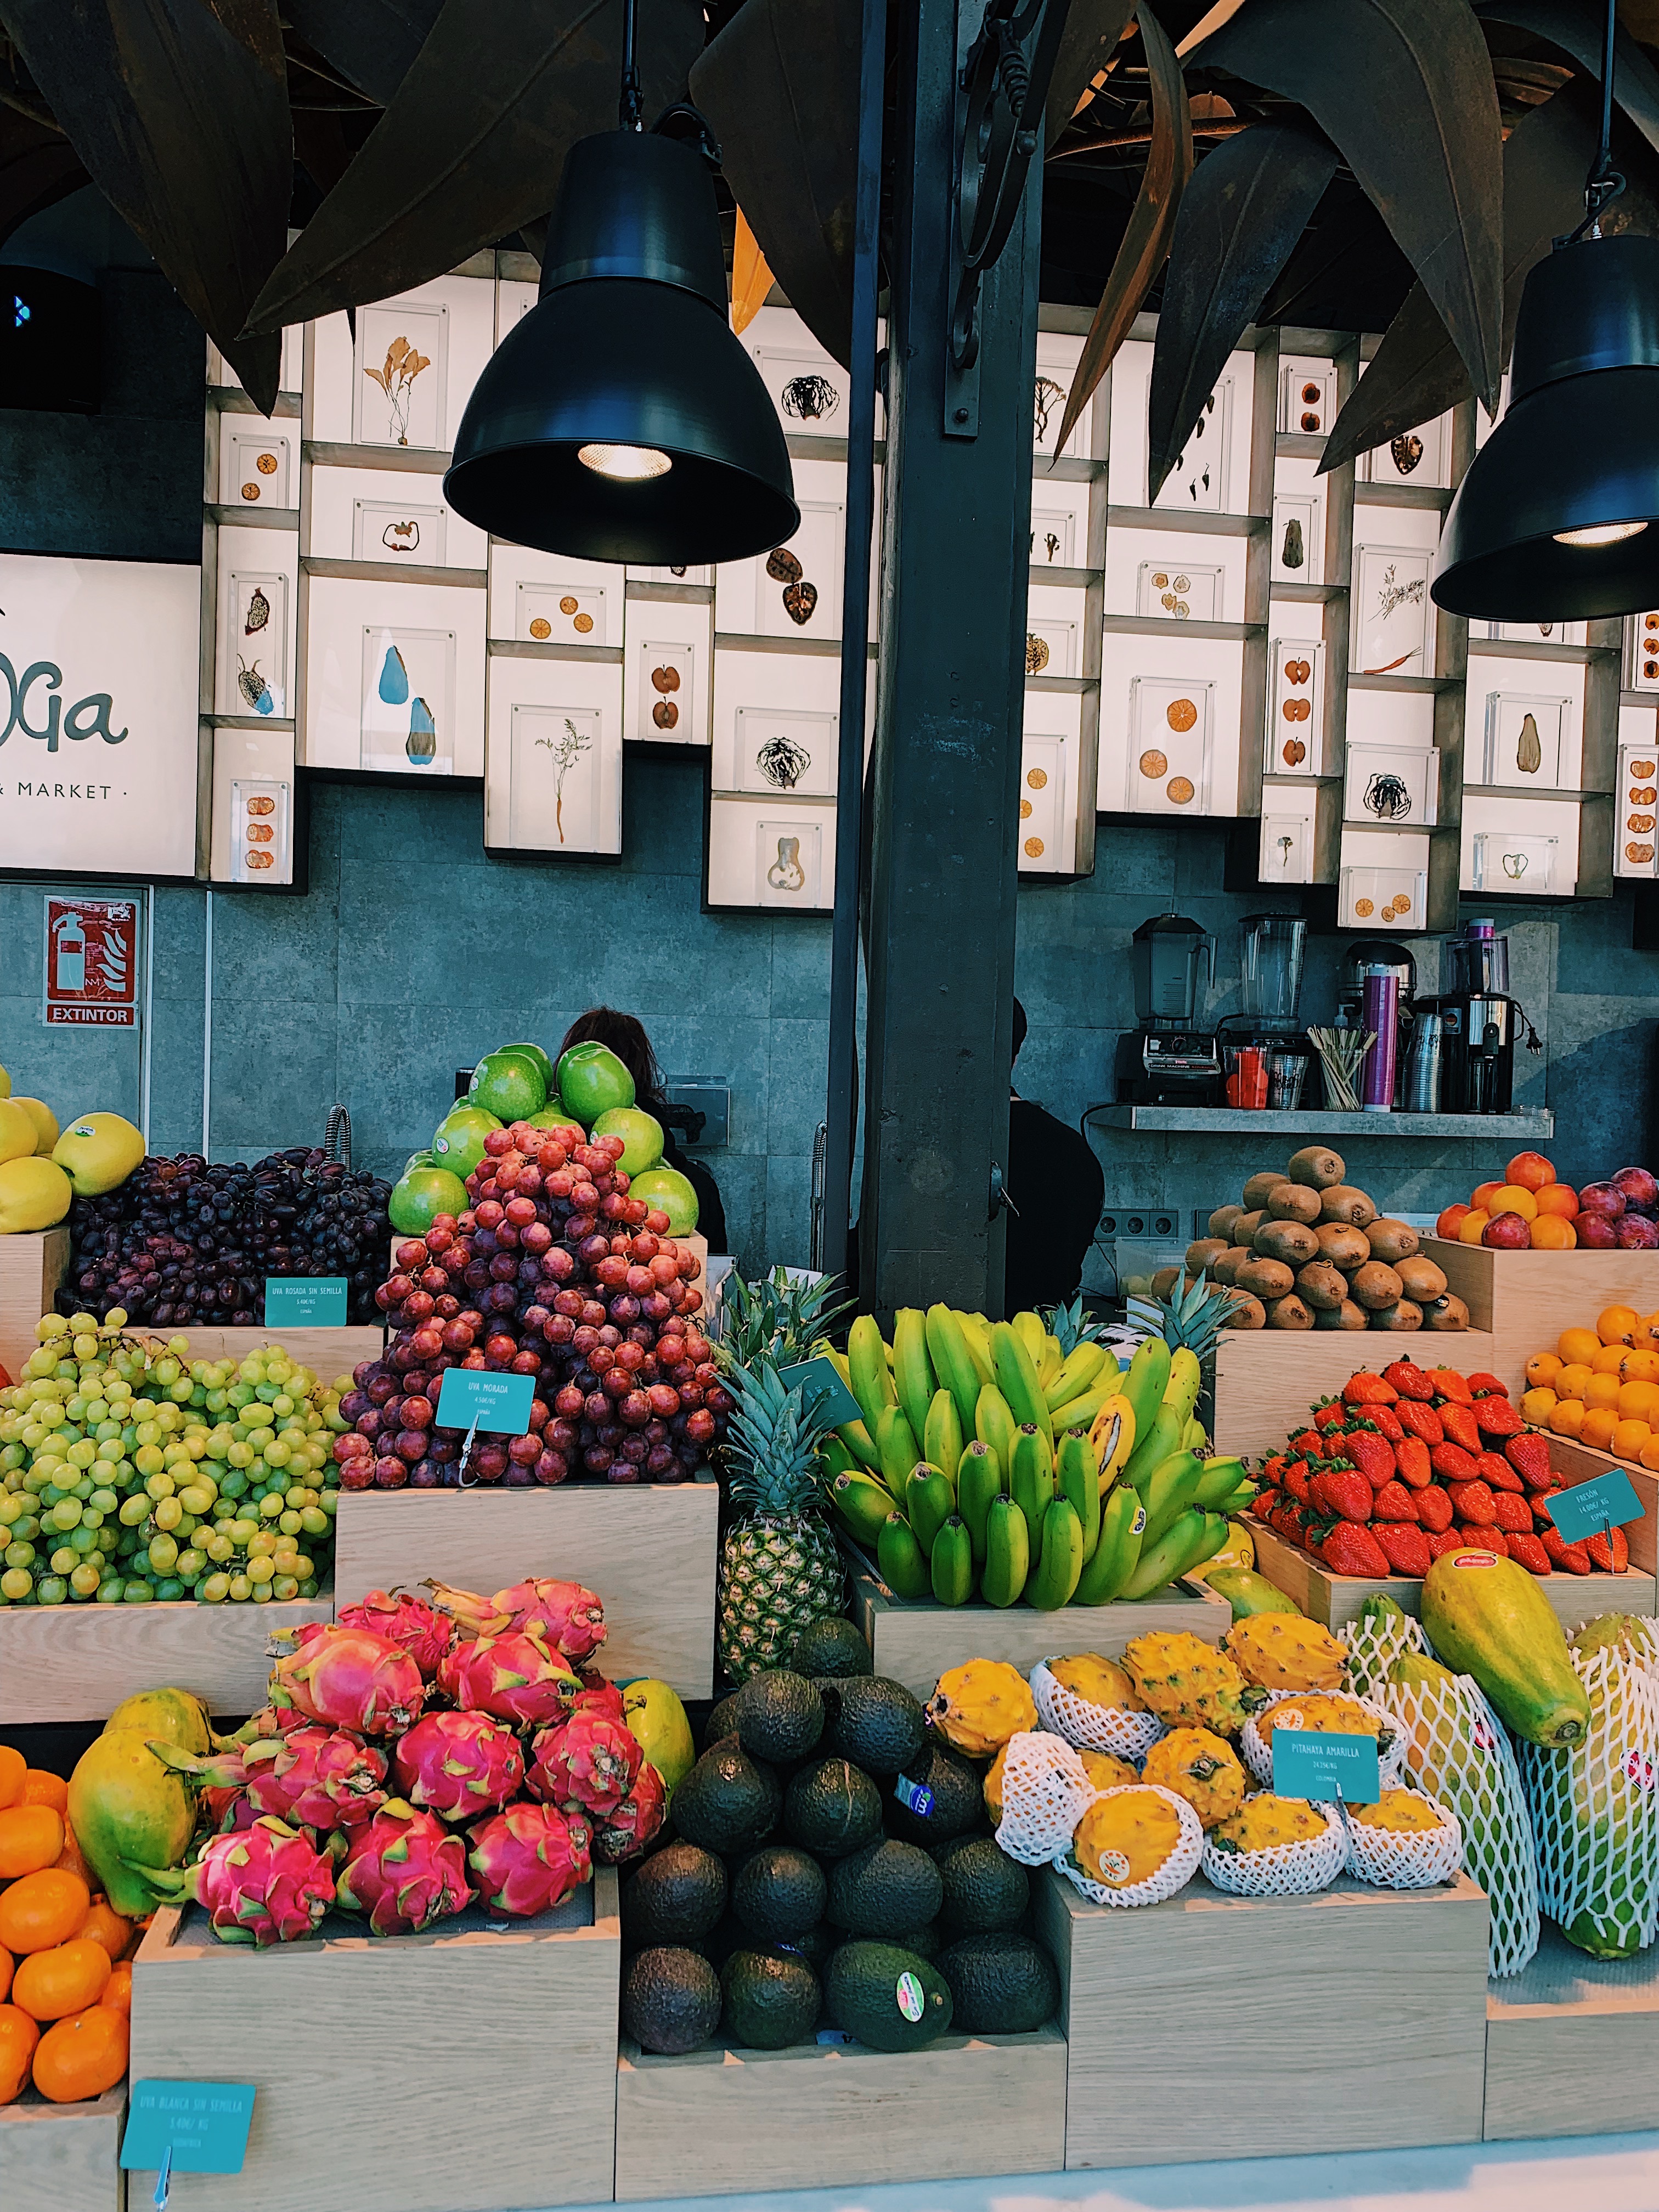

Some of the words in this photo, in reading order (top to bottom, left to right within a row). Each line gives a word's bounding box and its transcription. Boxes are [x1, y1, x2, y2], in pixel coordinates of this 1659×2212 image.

[18, 782, 111, 800] MARKET
[53, 1007, 127, 1023] EXTINTOR
[468, 1382, 480, 1391] UVA
[483, 1384, 509, 1394] MORADA
[1575, 1488, 1599, 1503] FRESÓN
[1590, 1509, 1610, 1522] ESPAÑA
[1291, 1743, 1324, 1755] PITAHAYA
[1326, 1746, 1360, 1758] AMARILLA
[140, 2095, 155, 2108] UVA
[159, 2096, 189, 2111] BLANCA
[193, 2098, 206, 2112] SIN
[210, 2098, 242, 2113] SEMILLA
